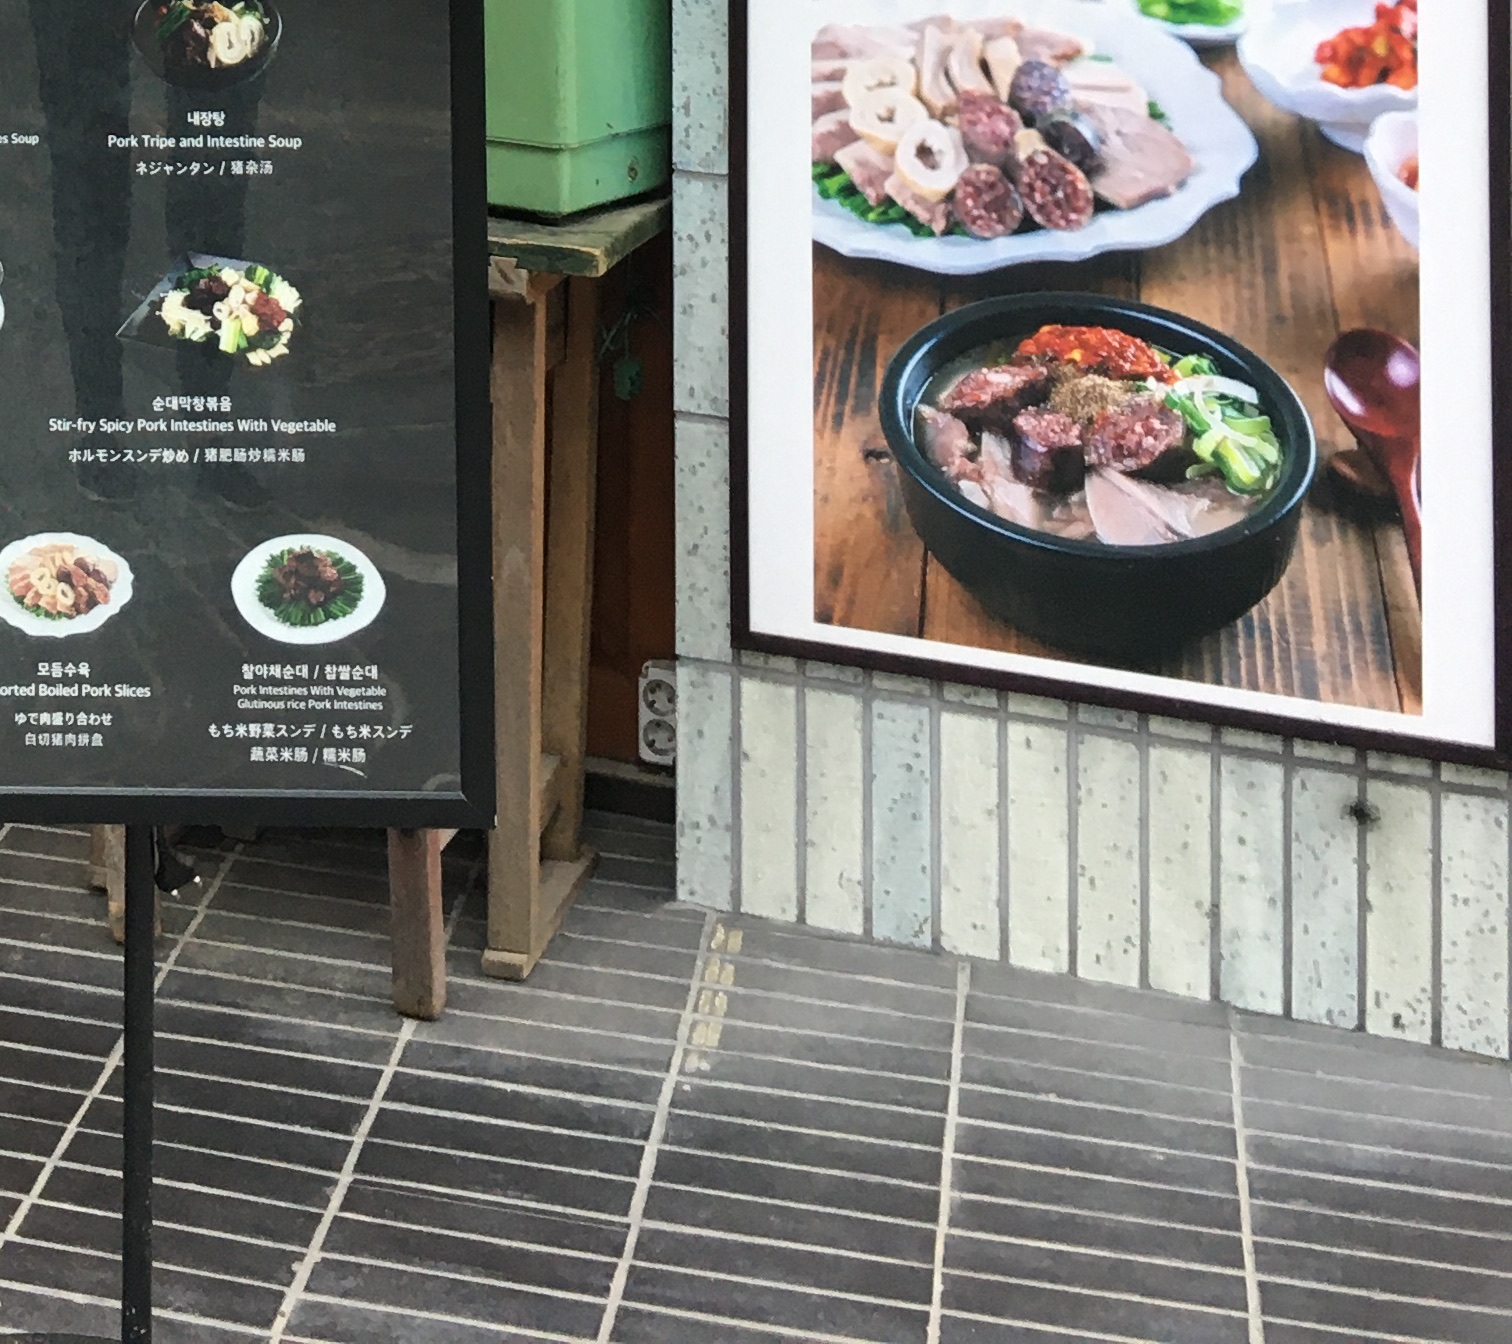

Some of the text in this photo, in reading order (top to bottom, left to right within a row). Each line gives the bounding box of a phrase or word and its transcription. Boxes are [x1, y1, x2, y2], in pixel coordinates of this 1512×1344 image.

[187, 111, 225, 126] 내장탕
[11, 133, 39, 146] Soup
[107, 134, 302, 149] Pork Tripe and Intestine Soup
[135, 160, 215, 175] ネジャンタン
[151, 396, 232, 412] 순대막창볶음
[48, 418, 336, 434] Stir-fry Spicy Pork Intestines With Vegetable
[37, 662, 90, 678] 모듬수육
[241, 664, 378, 680] 찰야채순대 찹쌀순대
[38, 684, 78, 697] Boiled
[82, 684, 112, 697] Pork
[114, 684, 151, 697] Slices
[233, 685, 387, 698] Pork Intestines With Vegetable
[237, 698, 383, 710] Glutinous rice Pork Intestines
[208, 723, 413, 739] もち米野菜スンデ もち米スンデ
